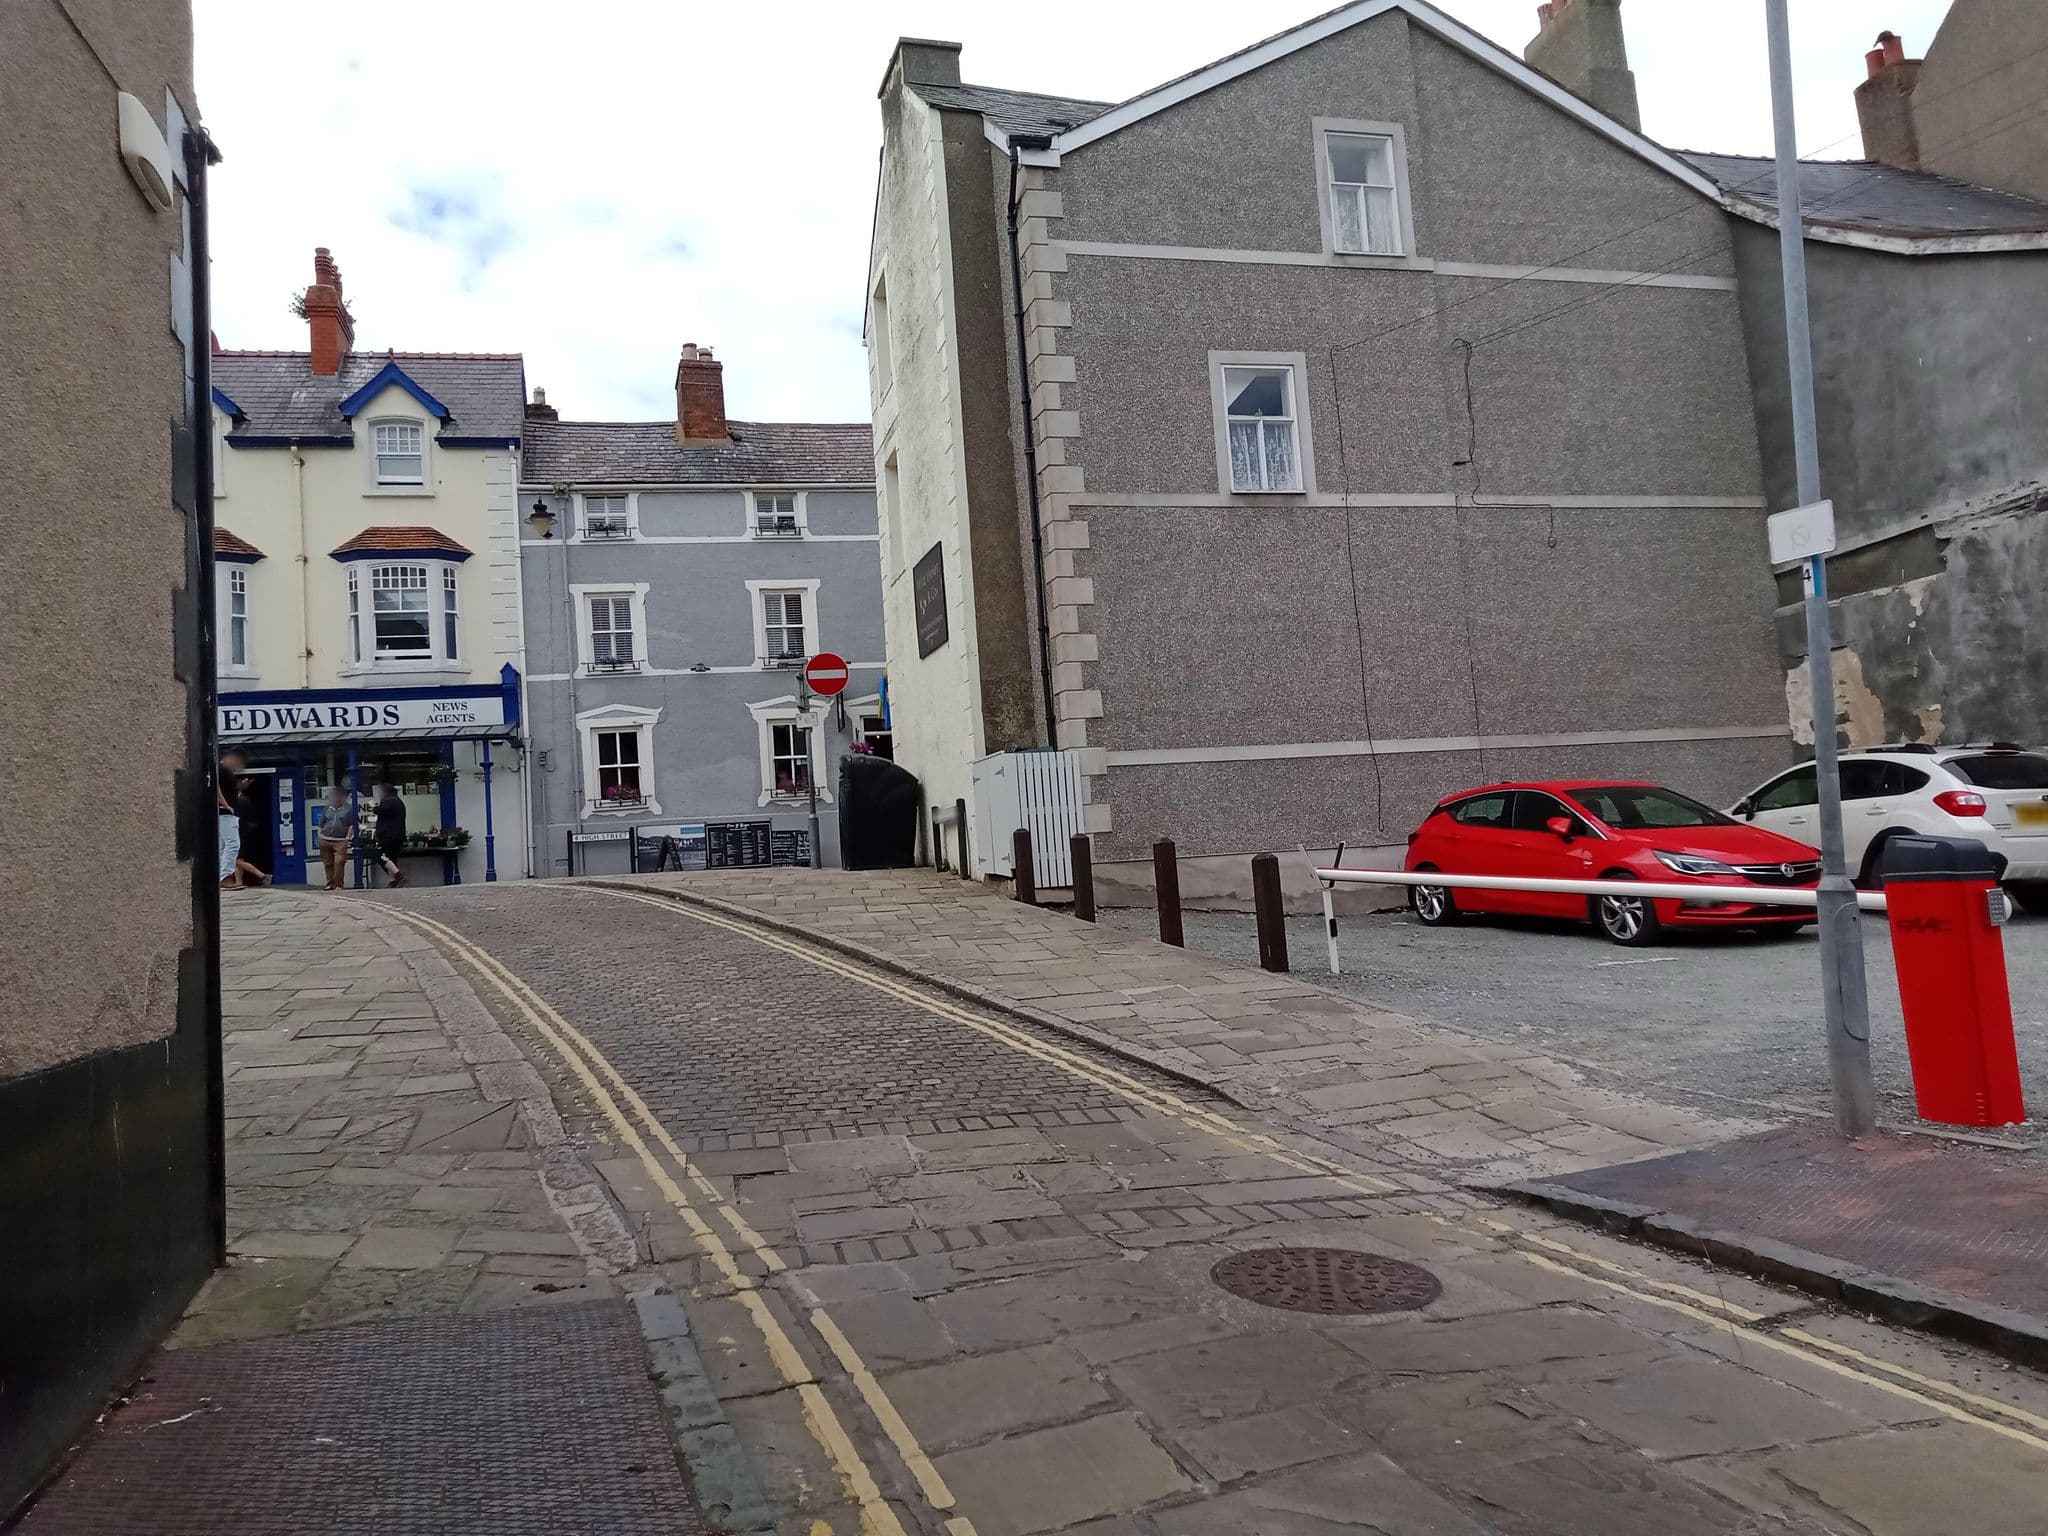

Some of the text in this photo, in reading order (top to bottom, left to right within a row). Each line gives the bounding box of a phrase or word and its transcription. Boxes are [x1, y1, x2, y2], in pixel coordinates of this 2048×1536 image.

[433, 701, 468, 711] NEWS
[221, 704, 401, 732] EDWARDS
[426, 713, 476, 724] AGENTS
